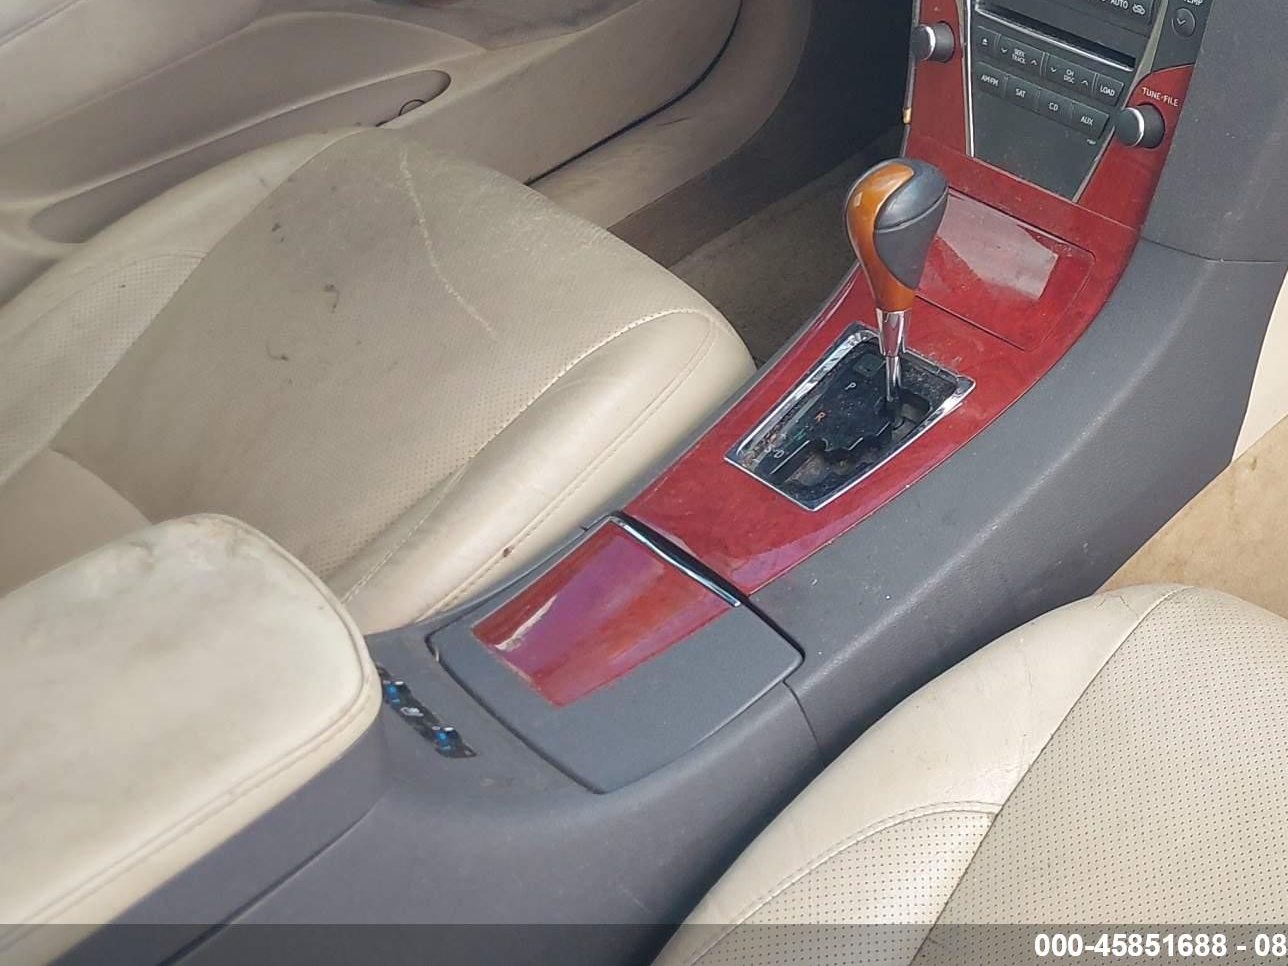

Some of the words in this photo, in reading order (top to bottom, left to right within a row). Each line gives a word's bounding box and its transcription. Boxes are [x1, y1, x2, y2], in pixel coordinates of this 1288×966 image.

[1015, 88, 1027, 98] SAT
[1100, 85, 1115, 97] LOAD
[1049, 102, 1059, 112] CD
[1080, 115, 1094, 127] AUX
[814, 411, 826, 423] R
